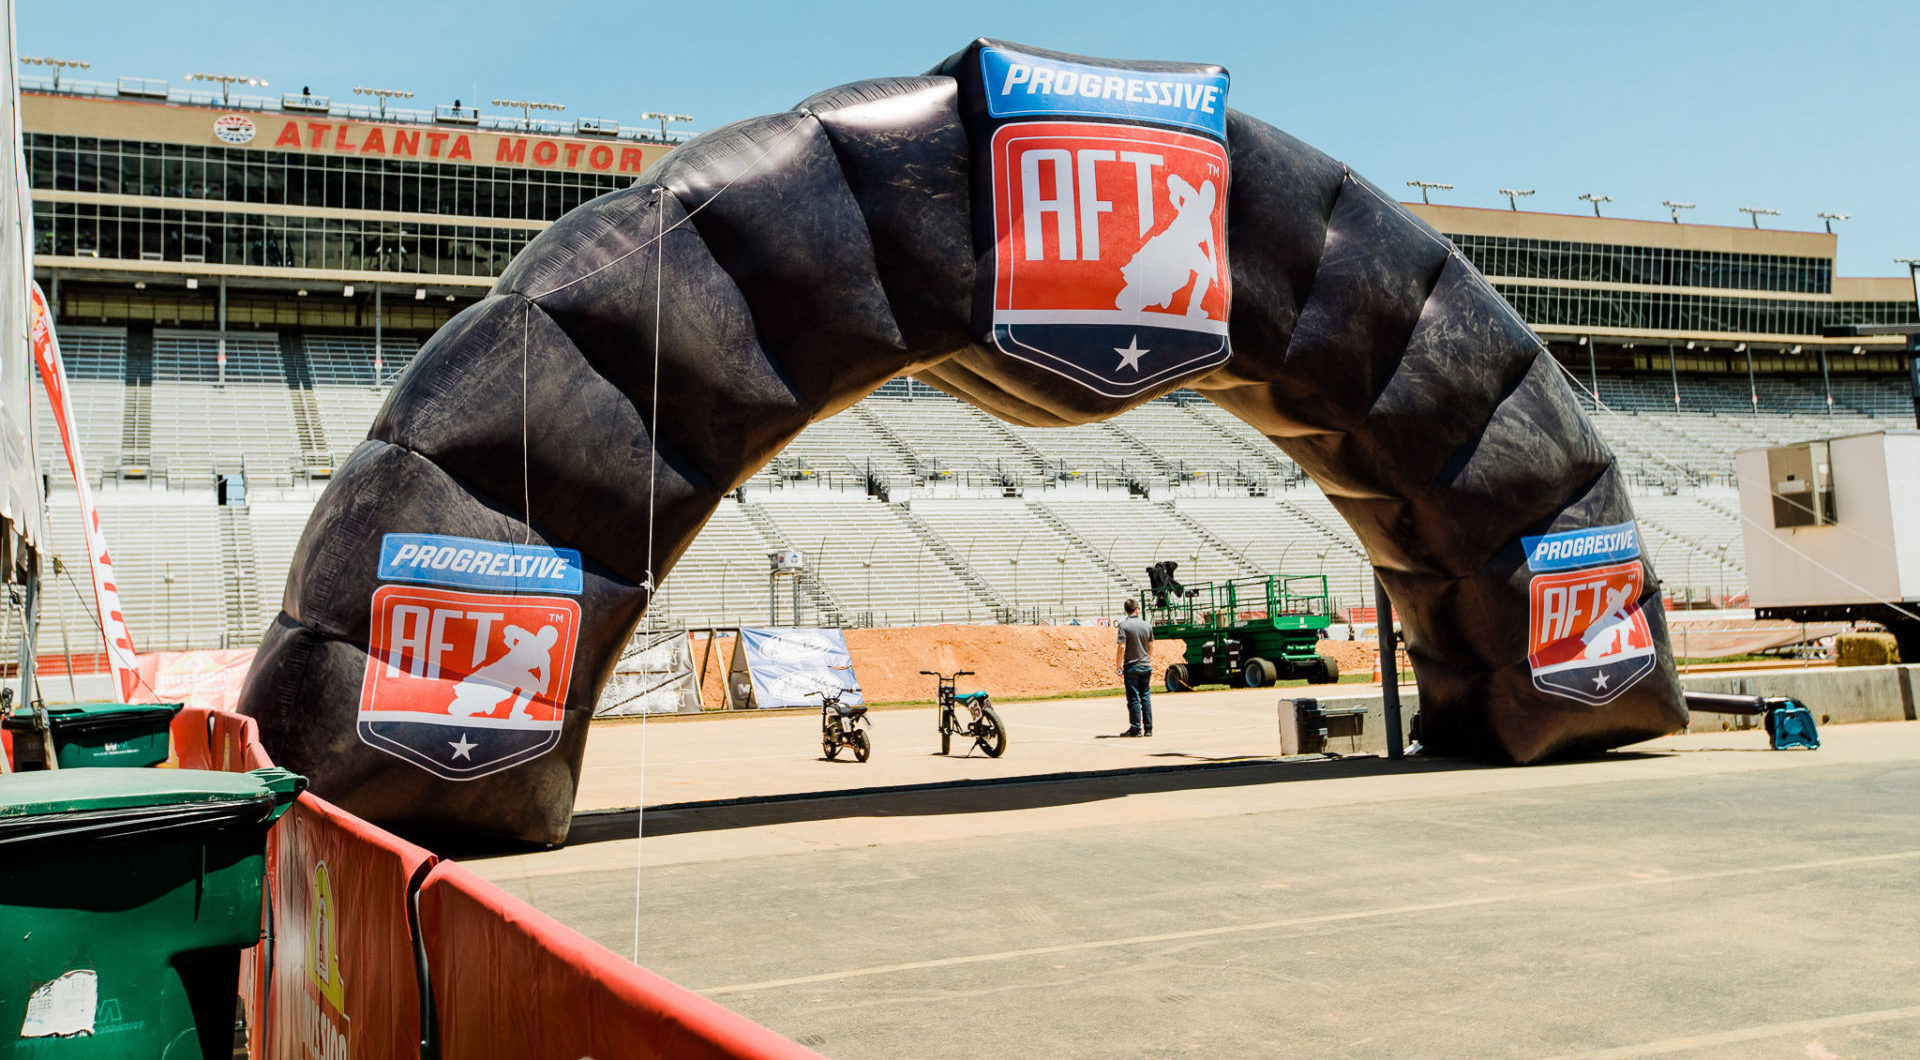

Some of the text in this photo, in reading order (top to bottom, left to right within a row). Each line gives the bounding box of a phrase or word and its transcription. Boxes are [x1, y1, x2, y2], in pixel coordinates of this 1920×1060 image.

[1002, 64, 1217, 114] PROGRESSIVE
[275, 121, 642, 173] ATLANTA MOTOR
[1208, 163, 1221, 178] TM
[1021, 149, 1164, 261] AFT
[390, 544, 569, 579] PROGRESSIVE
[1534, 529, 1633, 561] PROGRESSIVE
[548, 613, 564, 624] TM
[1541, 580, 1607, 644] AFT
[386, 605, 504, 680] AFT
